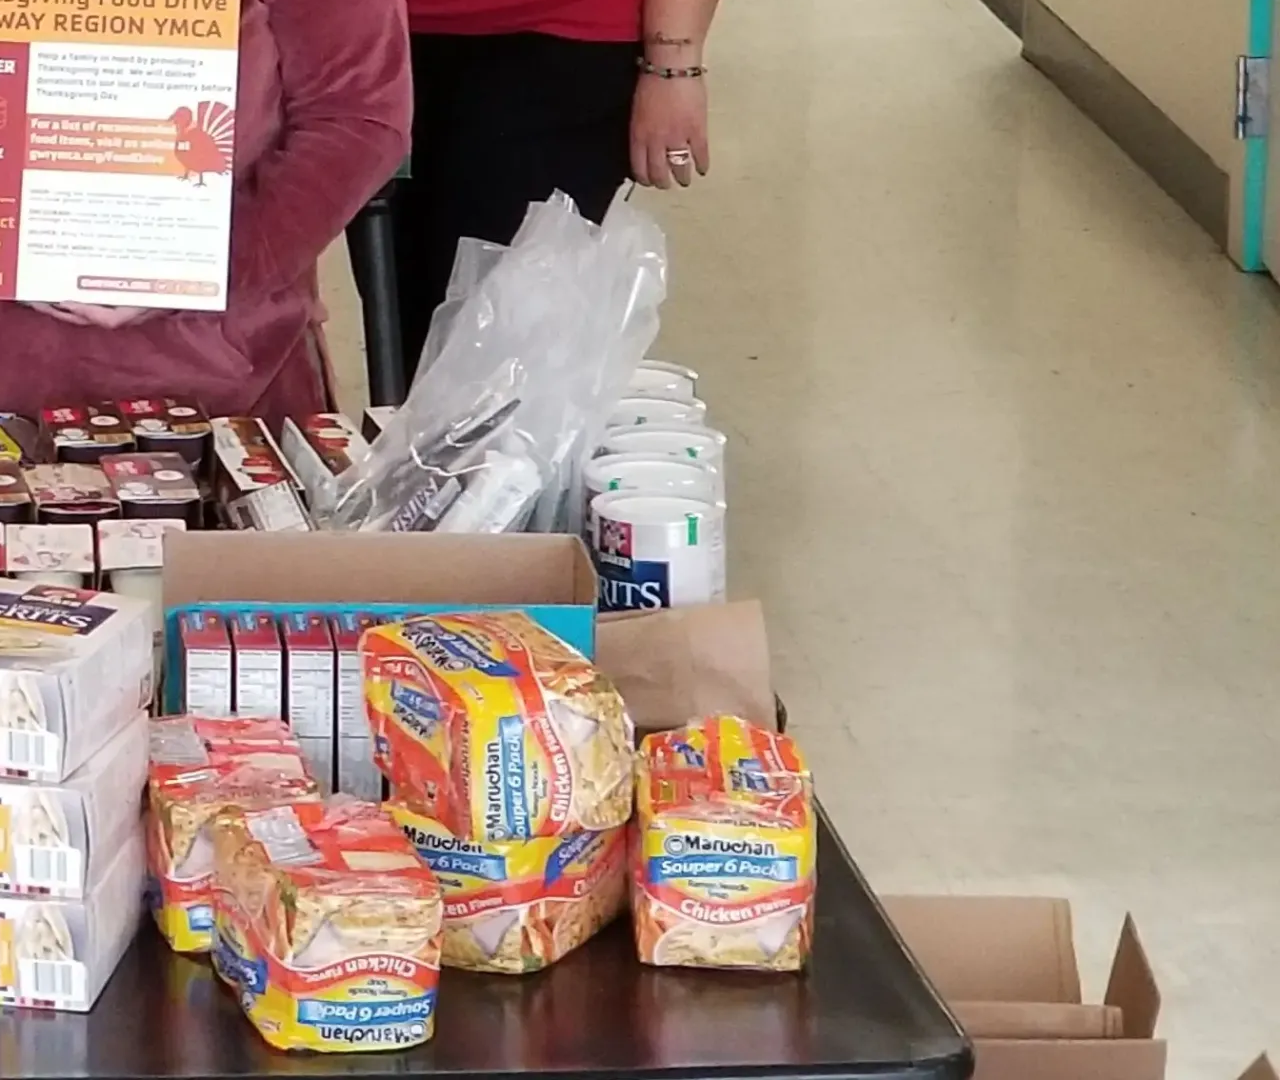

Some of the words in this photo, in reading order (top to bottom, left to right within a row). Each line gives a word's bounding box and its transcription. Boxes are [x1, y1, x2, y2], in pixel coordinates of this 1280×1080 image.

[53, 13, 145, 34] REGION
[153, 18, 223, 38] YMCA
[68, 53, 98, 64] family
[112, 55, 134, 64] need
[137, 56, 148, 65] by
[150, 58, 196, 68] providing
[37, 64, 100, 77] Thanksgiving
[165, 70, 197, 78] deliver
[36, 76, 84, 87] donations
[143, 80, 165, 90] food
[167, 82, 199, 93] pantry
[201, 84, 233, 93] before
[36, 88, 99, 101] Thanksgiving
[30, 118, 50, 130] For
[30, 133, 58, 146] food
[598, 580, 663, 611] RITS
[510, 733, 524, 771] Pack
[485, 739, 502, 828] Maruchan
[512, 775, 523, 793] 6
[550, 752, 572, 825] Chicken
[684, 834, 775, 857] Maruchan
[661, 860, 721, 875] Souper
[723, 860, 738, 874] 6
[739, 860, 778, 876] Pack
[680, 899, 753, 923] Chicken
[344, 957, 417, 978] Chicken
[359, 1003, 372, 1021] 6
[374, 1000, 431, 1019] Souper
[321, 1024, 410, 1046] Maruchan
